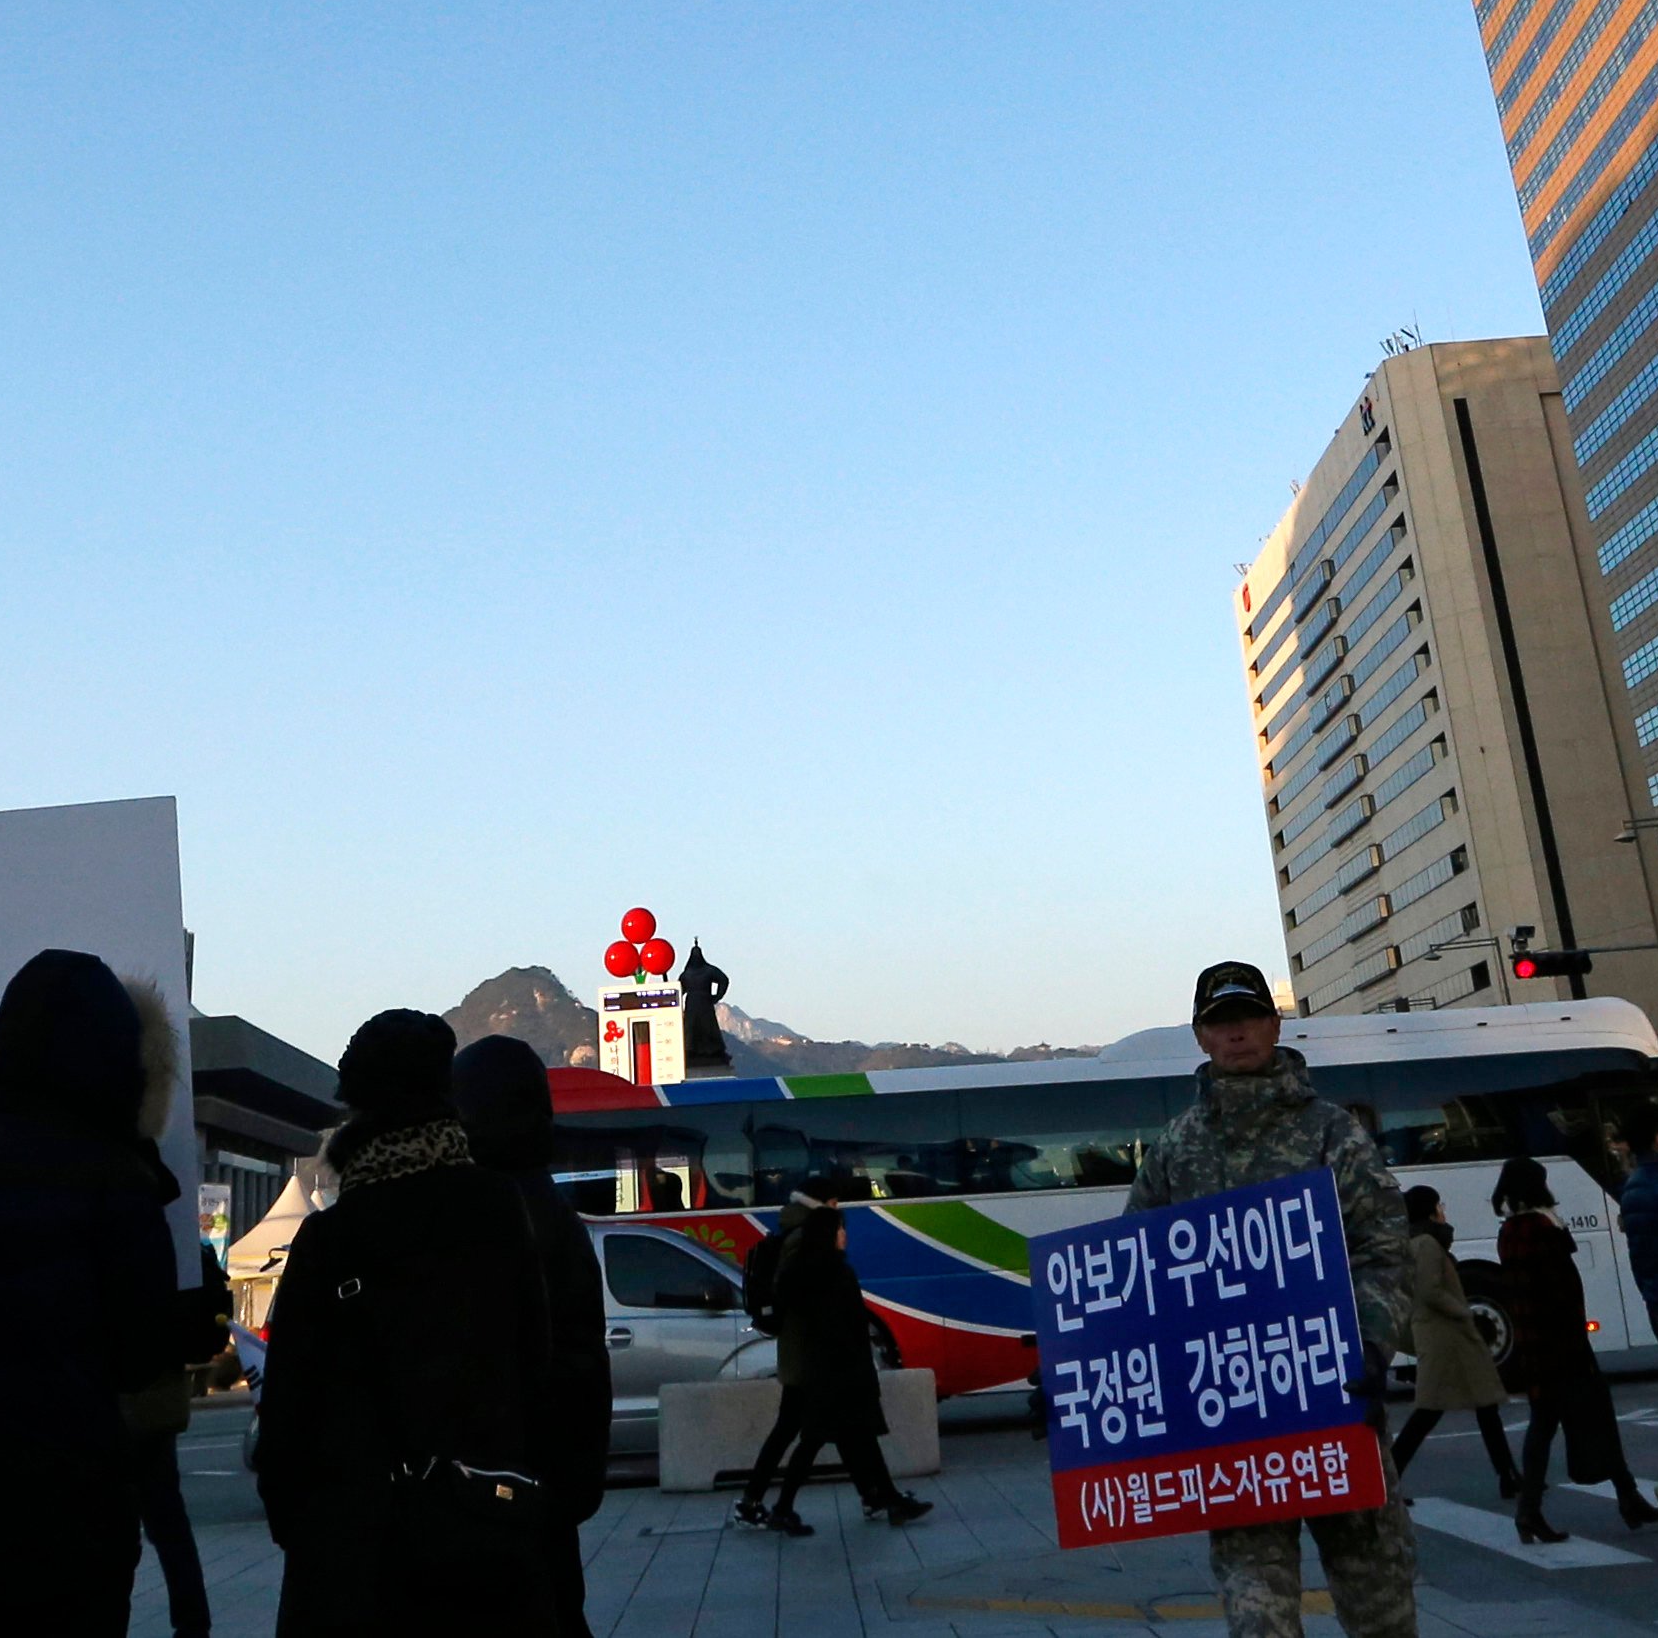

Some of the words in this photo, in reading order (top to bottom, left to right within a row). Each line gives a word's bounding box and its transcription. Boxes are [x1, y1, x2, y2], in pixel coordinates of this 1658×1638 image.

[1047, 1228, 1156, 1333] 안보가
[1167, 1188, 1324, 1307] 우선이다
[1053, 1343, 1167, 1448] 국정원
[1185, 1307, 1350, 1429] 강화하라
[1079, 1441, 1350, 1531] (사)월드피스자유연합
